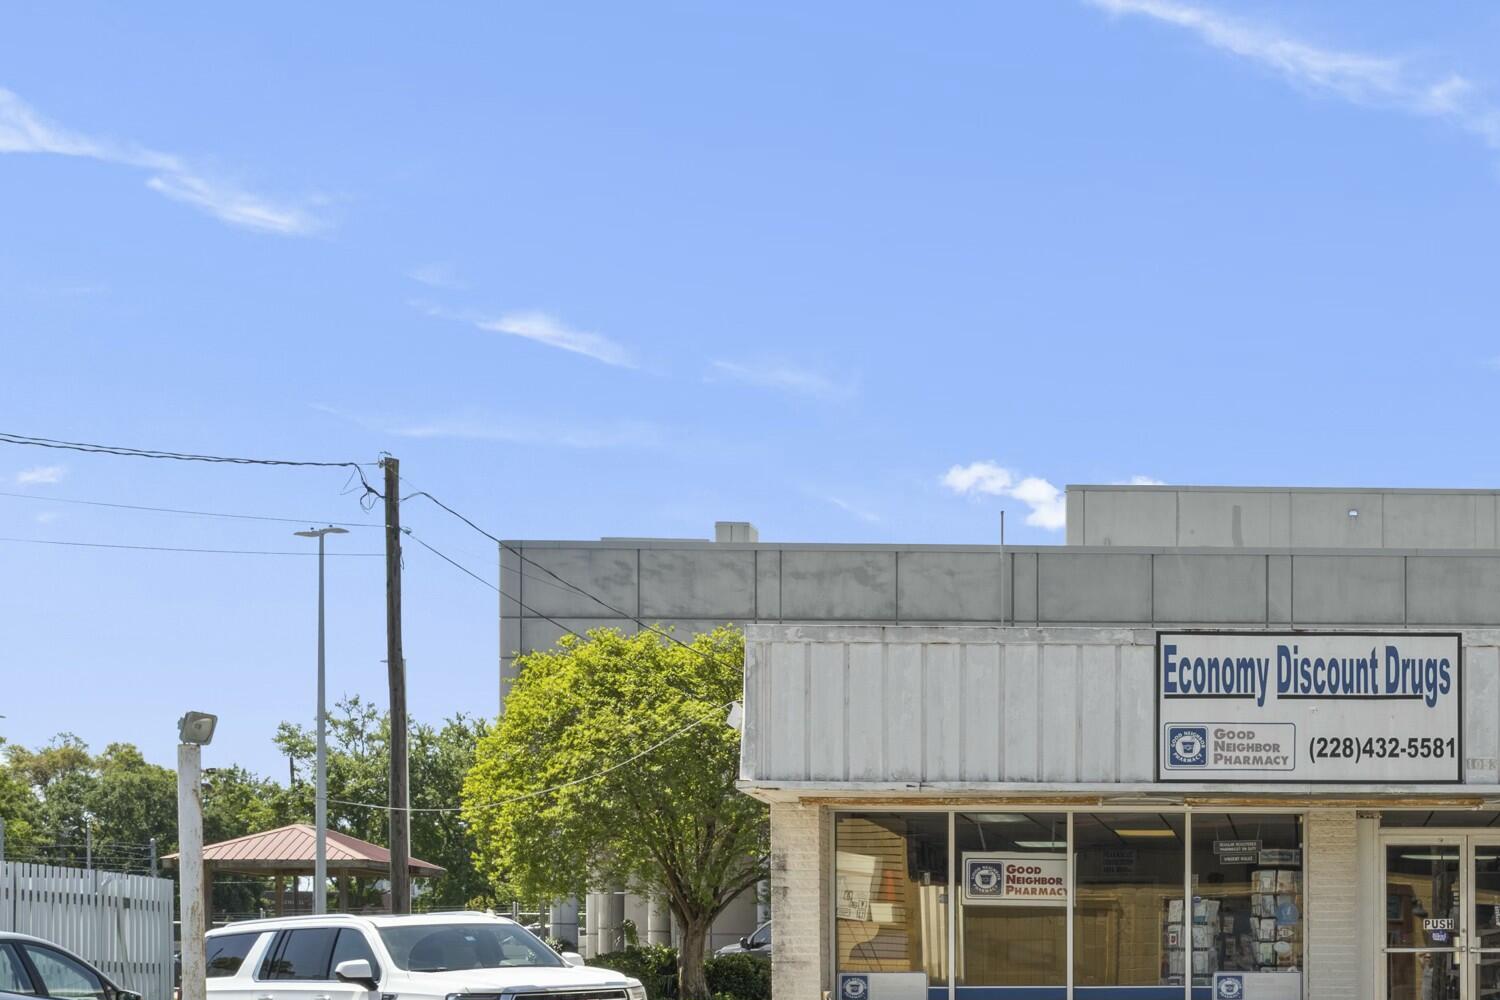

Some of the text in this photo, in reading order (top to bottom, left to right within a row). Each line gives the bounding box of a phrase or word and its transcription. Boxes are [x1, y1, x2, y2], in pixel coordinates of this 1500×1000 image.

[1163, 644, 1451, 708] Economy Discount Drugs
[1214, 728, 1256, 740] GOOD
[1214, 740, 1280, 753] NEIGHBOR
[1309, 736, 1456, 764] (228)432-5581
[1214, 753, 1289, 766] PHARMACY
[1006, 864, 1042, 875] GOOD
[1006, 875, 1063, 885] NEIGHBOR
[1424, 919, 1454, 929] PUSH
